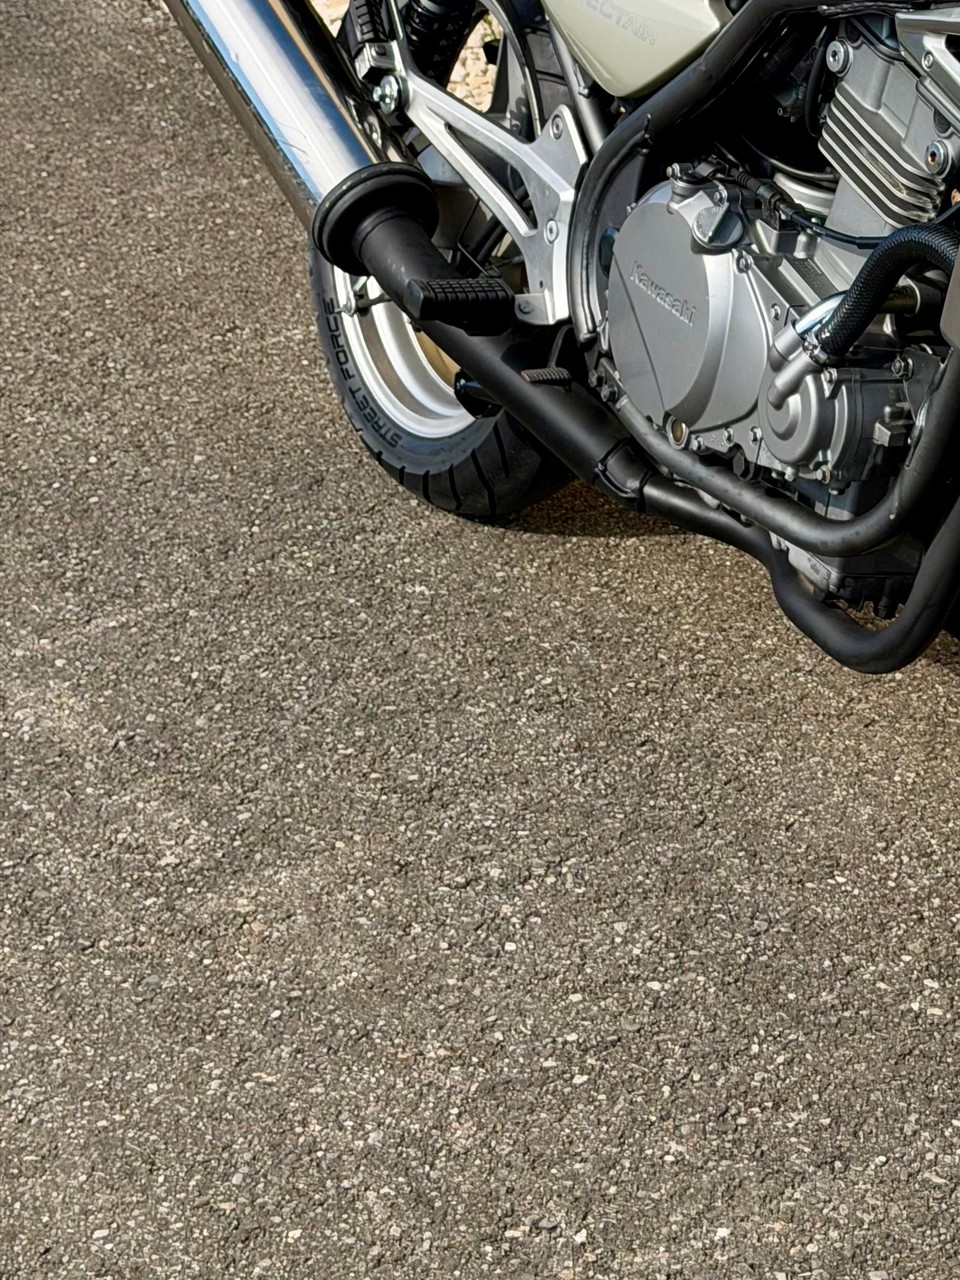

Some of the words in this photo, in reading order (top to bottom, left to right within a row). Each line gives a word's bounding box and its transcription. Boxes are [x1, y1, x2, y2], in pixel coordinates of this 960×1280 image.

[629, 260, 698, 328] Kawasaki
[322, 296, 356, 382] FORCE
[348, 386, 403, 449] STREET
